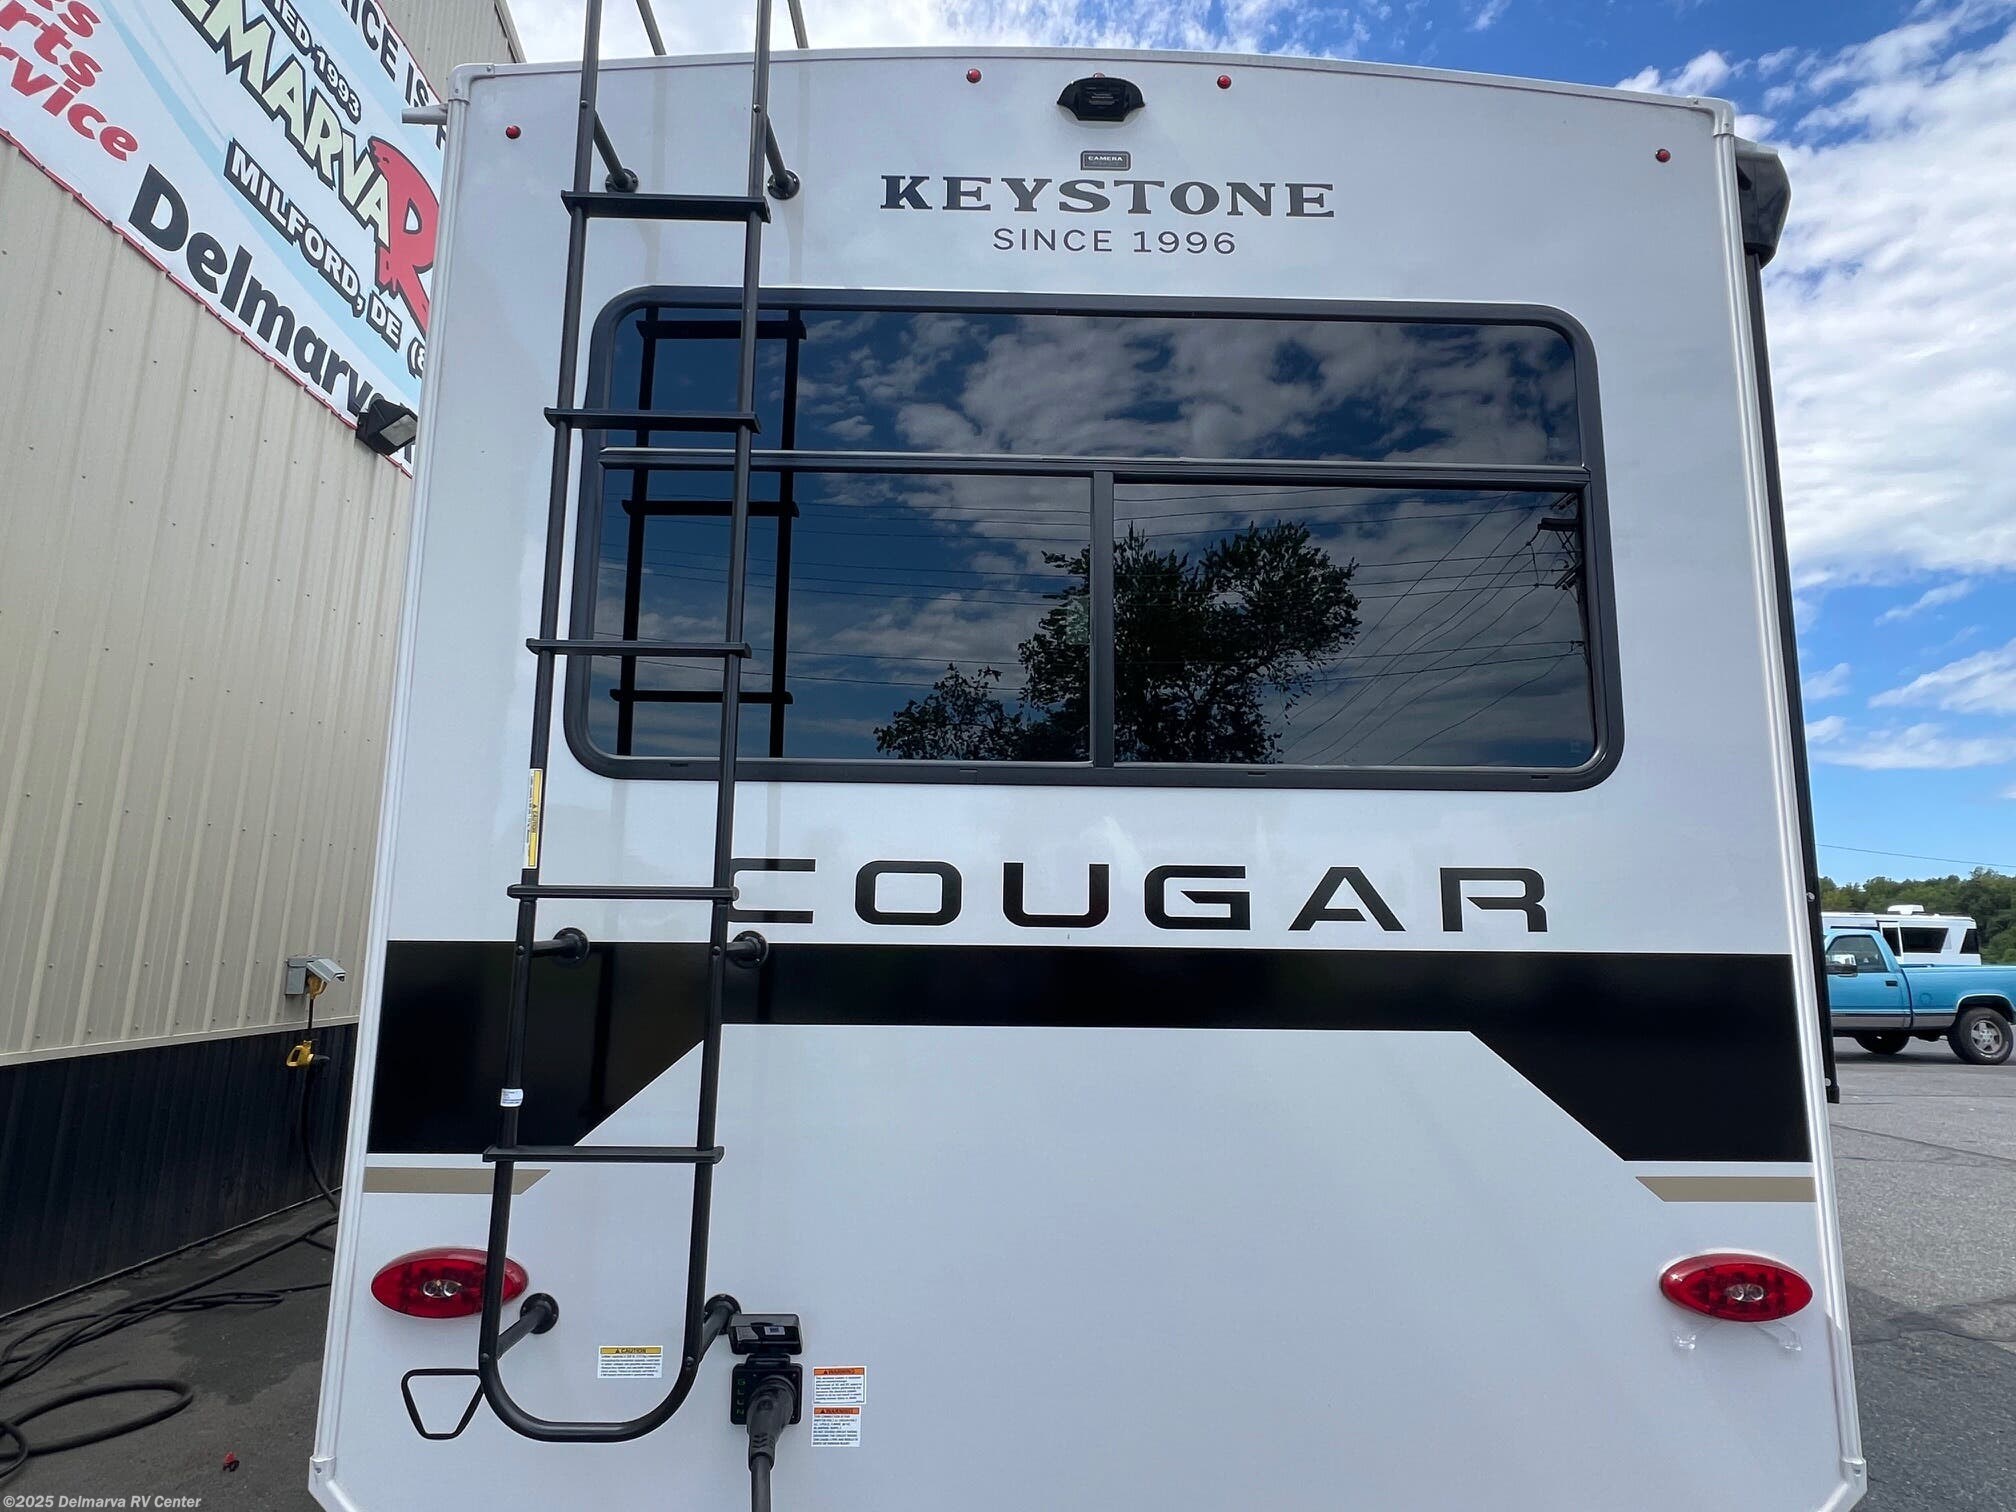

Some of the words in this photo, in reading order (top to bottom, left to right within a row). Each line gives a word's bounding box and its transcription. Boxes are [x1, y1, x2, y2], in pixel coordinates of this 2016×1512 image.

[341, 0, 398, 82] ICE
[312, 44, 362, 124] 1993
[172, 0, 391, 250] MARVA
[880, 175, 1335, 218] KEYSTONE
[226, 140, 365, 316] MILFORD,
[367, 291, 402, 350] DE
[993, 227, 1112, 252] SINCE
[1133, 230, 1236, 255] 1996
[128, 163, 385, 417] Delmarv
[728, 857, 1547, 932] COUGAR
